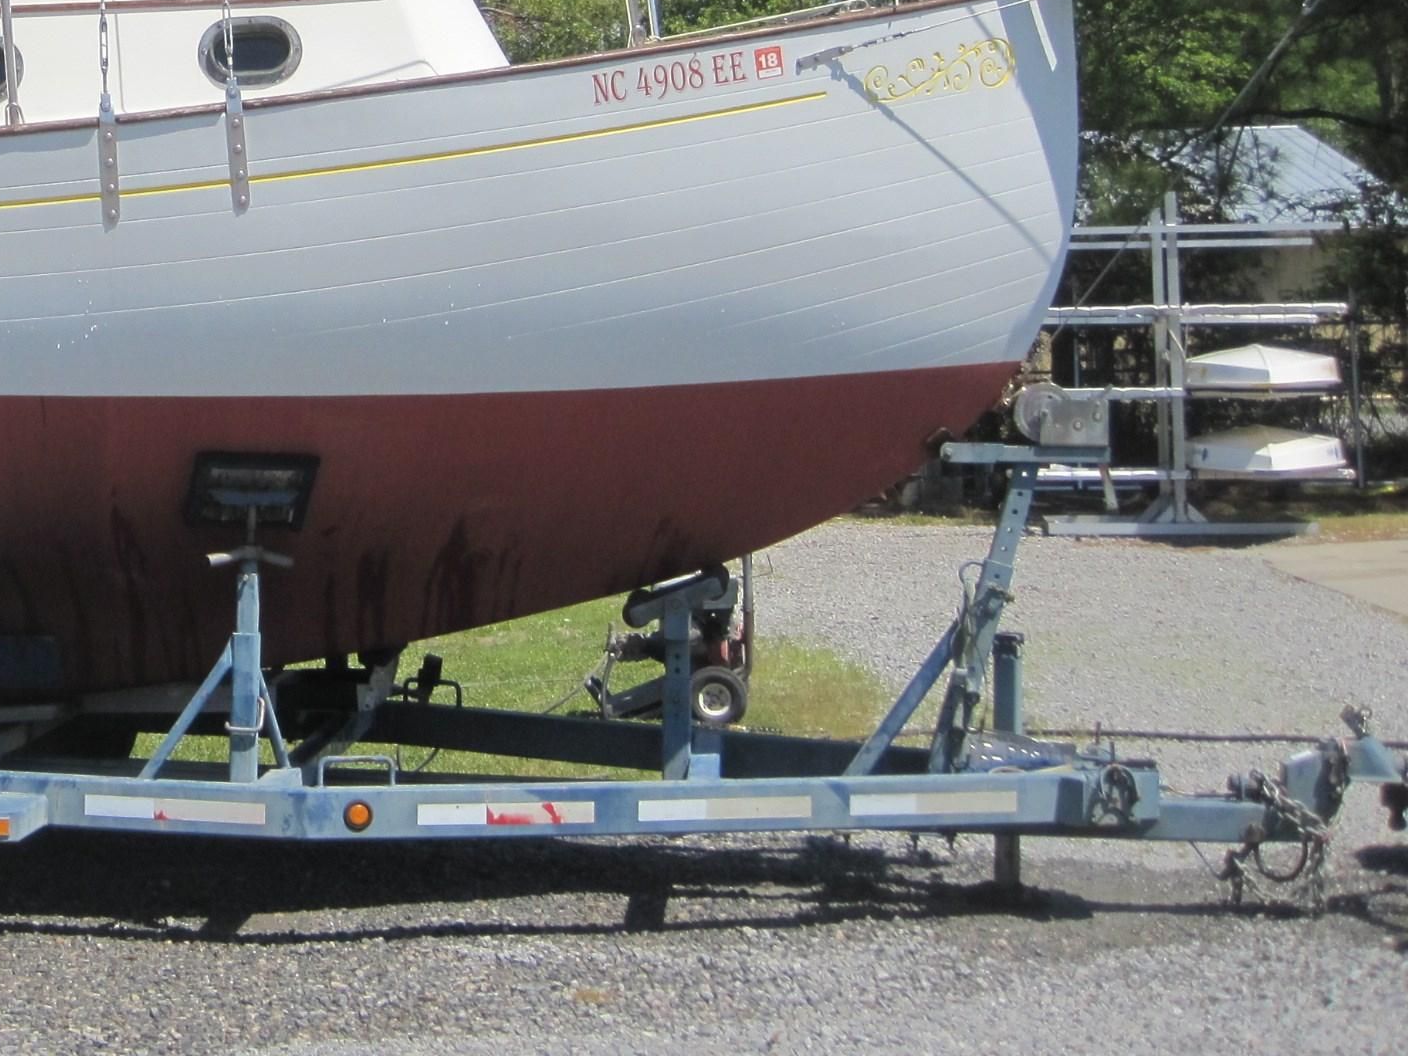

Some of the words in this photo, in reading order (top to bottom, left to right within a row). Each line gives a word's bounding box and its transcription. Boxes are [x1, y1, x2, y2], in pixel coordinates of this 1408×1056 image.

[758, 52, 779, 69] 18
[592, 70, 627, 105] NC
[636, 53, 704, 99] 4908
[712, 52, 747, 85] EE
